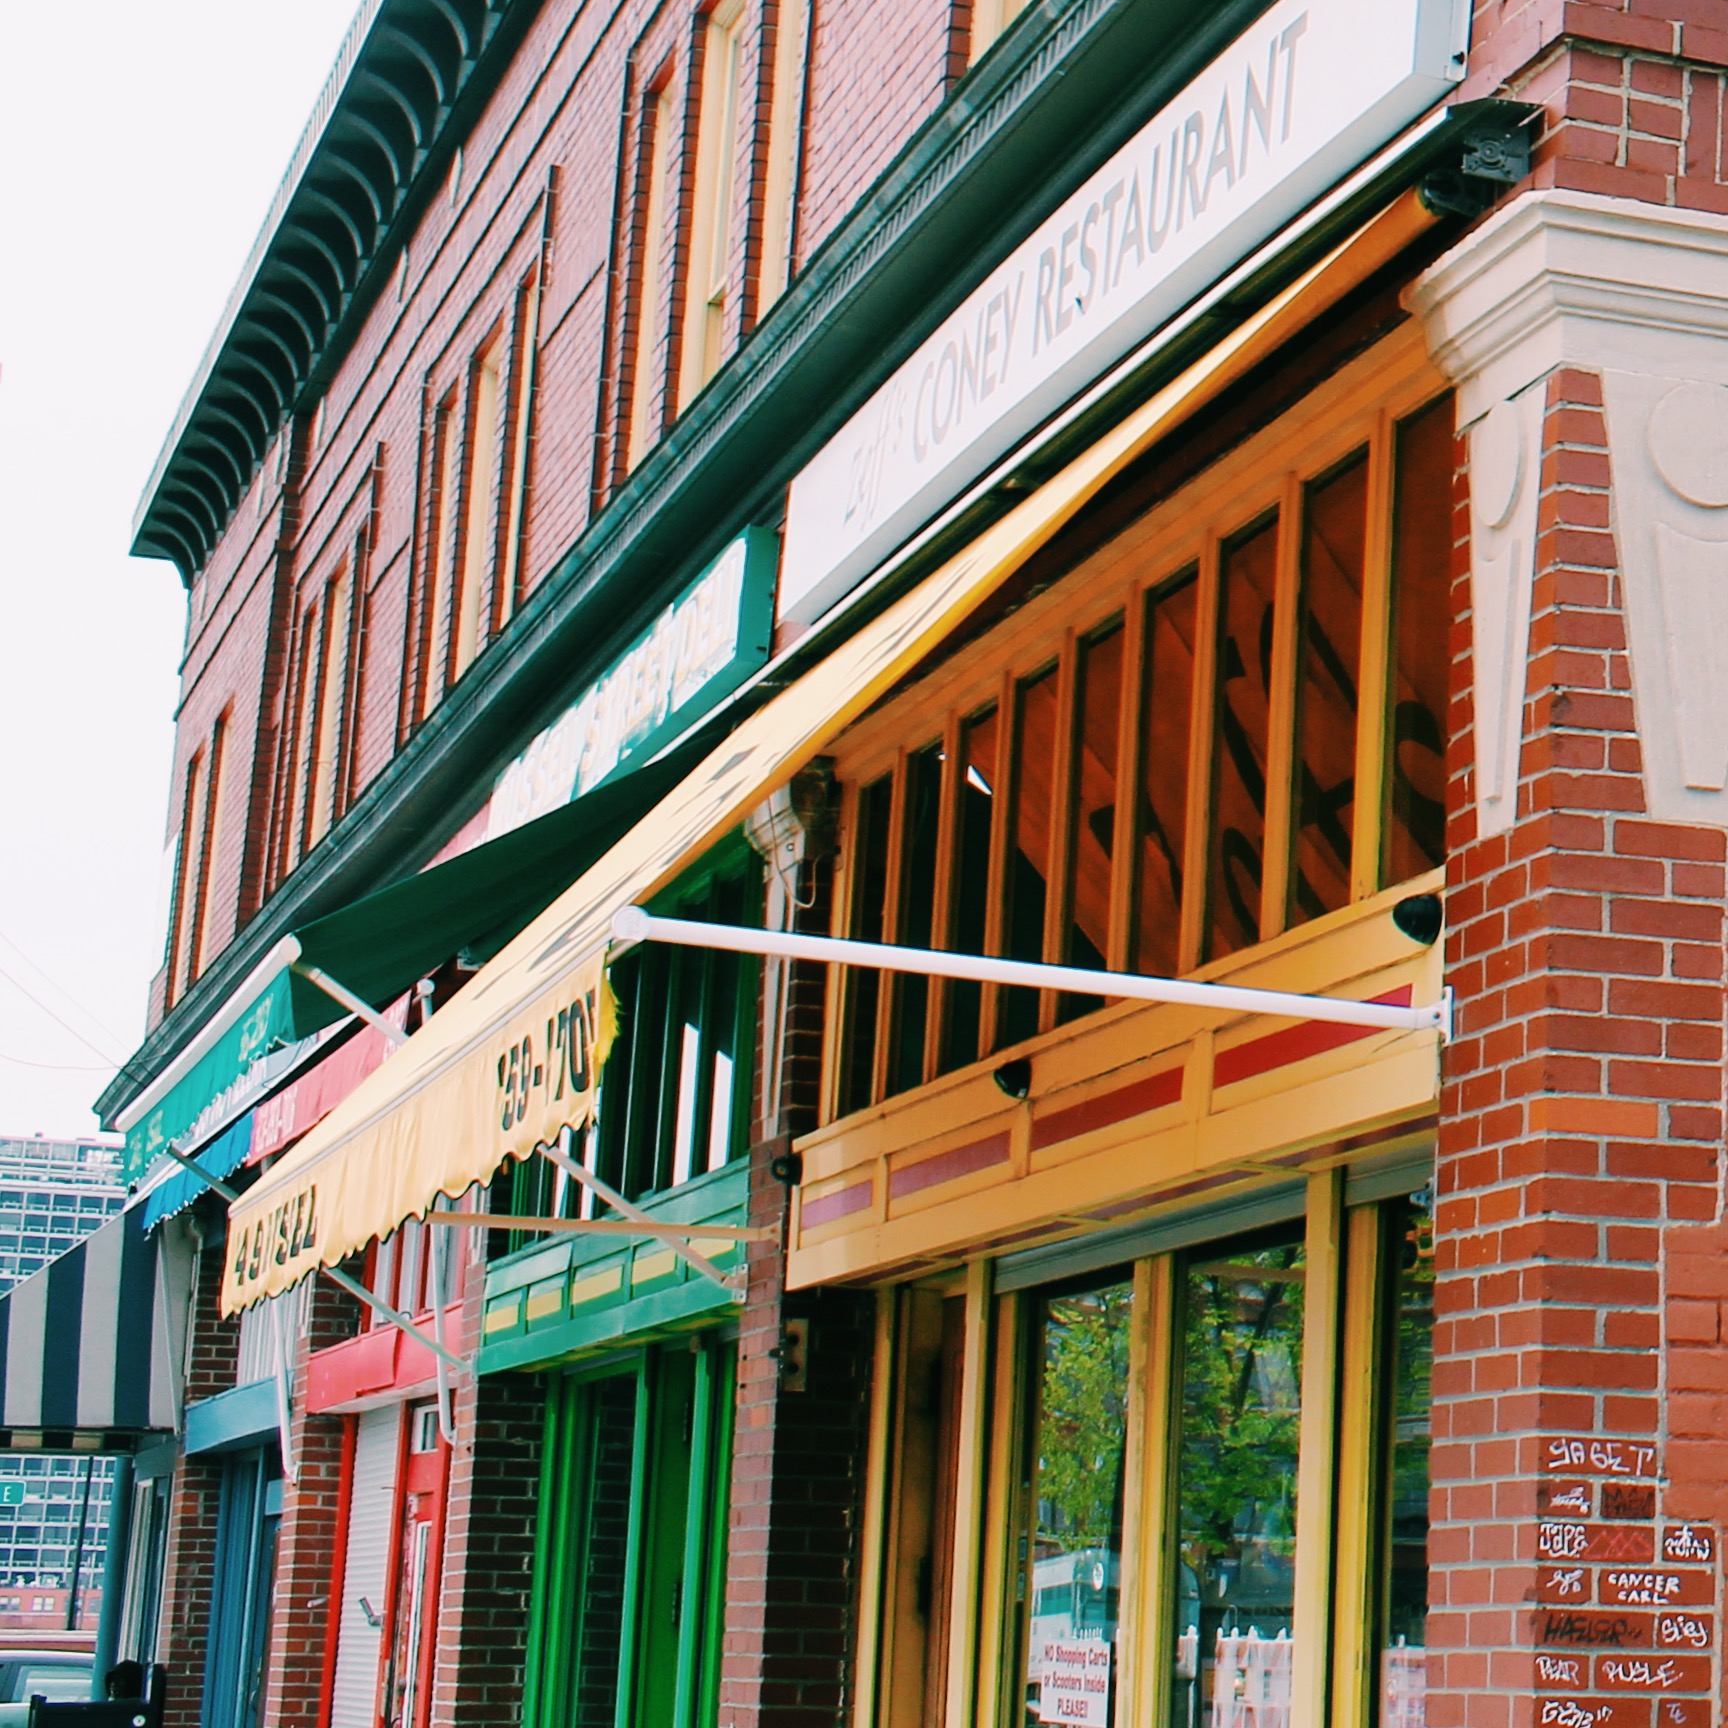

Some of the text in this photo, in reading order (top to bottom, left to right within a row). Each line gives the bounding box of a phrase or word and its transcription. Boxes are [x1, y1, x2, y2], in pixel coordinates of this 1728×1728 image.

[913, 268, 1028, 464] CONEY
[1032, 10, 1308, 357] RESTAURANT
[1607, 1572, 1682, 1595] CANCER
[1617, 1590, 1669, 1605] CARL
[1056, 1645, 1087, 1670] Shopping
[1088, 1647, 1108, 1666] Carts
